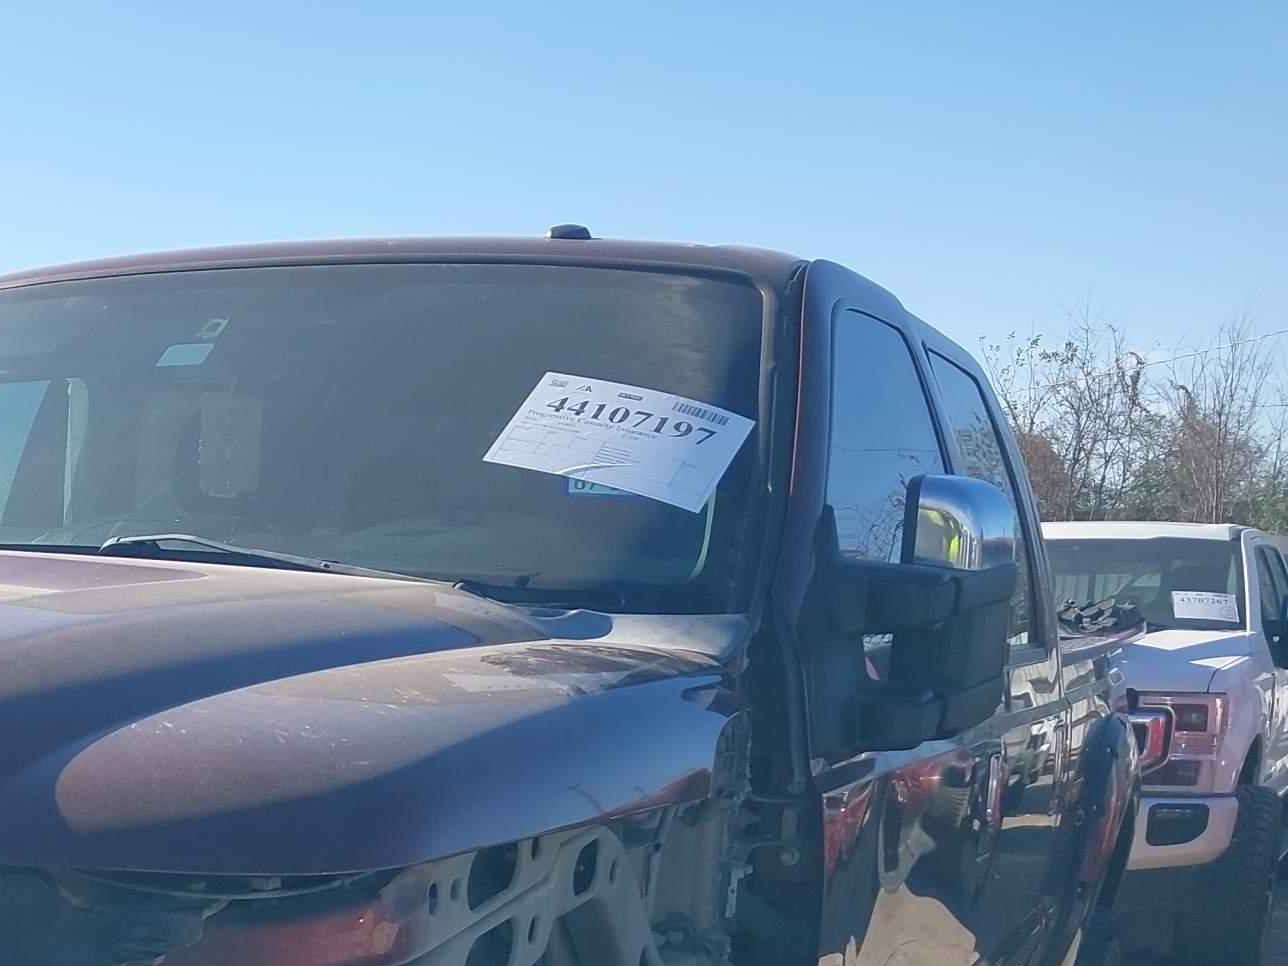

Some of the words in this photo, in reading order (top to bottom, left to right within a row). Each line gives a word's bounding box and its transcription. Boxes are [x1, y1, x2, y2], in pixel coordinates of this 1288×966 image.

[527, 408, 575, 422] Progressive
[577, 417, 613, 431] Casualty
[615, 425, 659, 440] Insurance
[546, 396, 718, 445] 44107197
